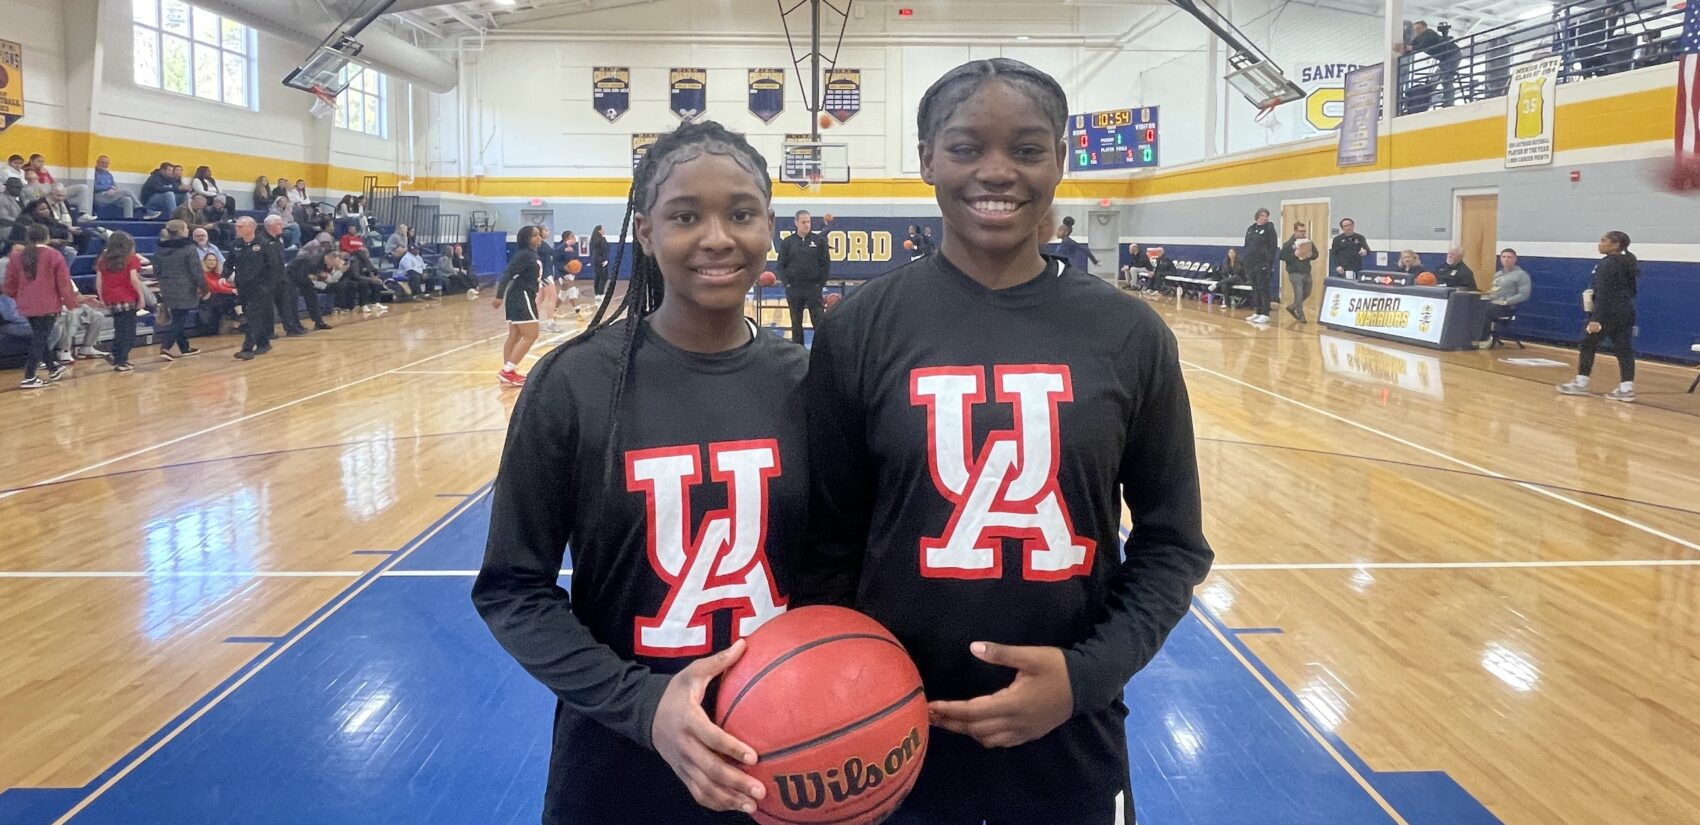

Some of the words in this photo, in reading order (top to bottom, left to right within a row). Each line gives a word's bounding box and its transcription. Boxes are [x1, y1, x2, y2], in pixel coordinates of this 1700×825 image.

[1098, 111, 1129, 125] 10:54
[1080, 135, 1088, 148] 0
[1146, 129, 1155, 142] 0
[1080, 153, 1088, 166] 0
[1143, 149, 1152, 162] 0
[1348, 297, 1401, 313] SANFORD
[1355, 310, 1410, 329] WARRIORS
[774, 727, 922, 811] Wilson
